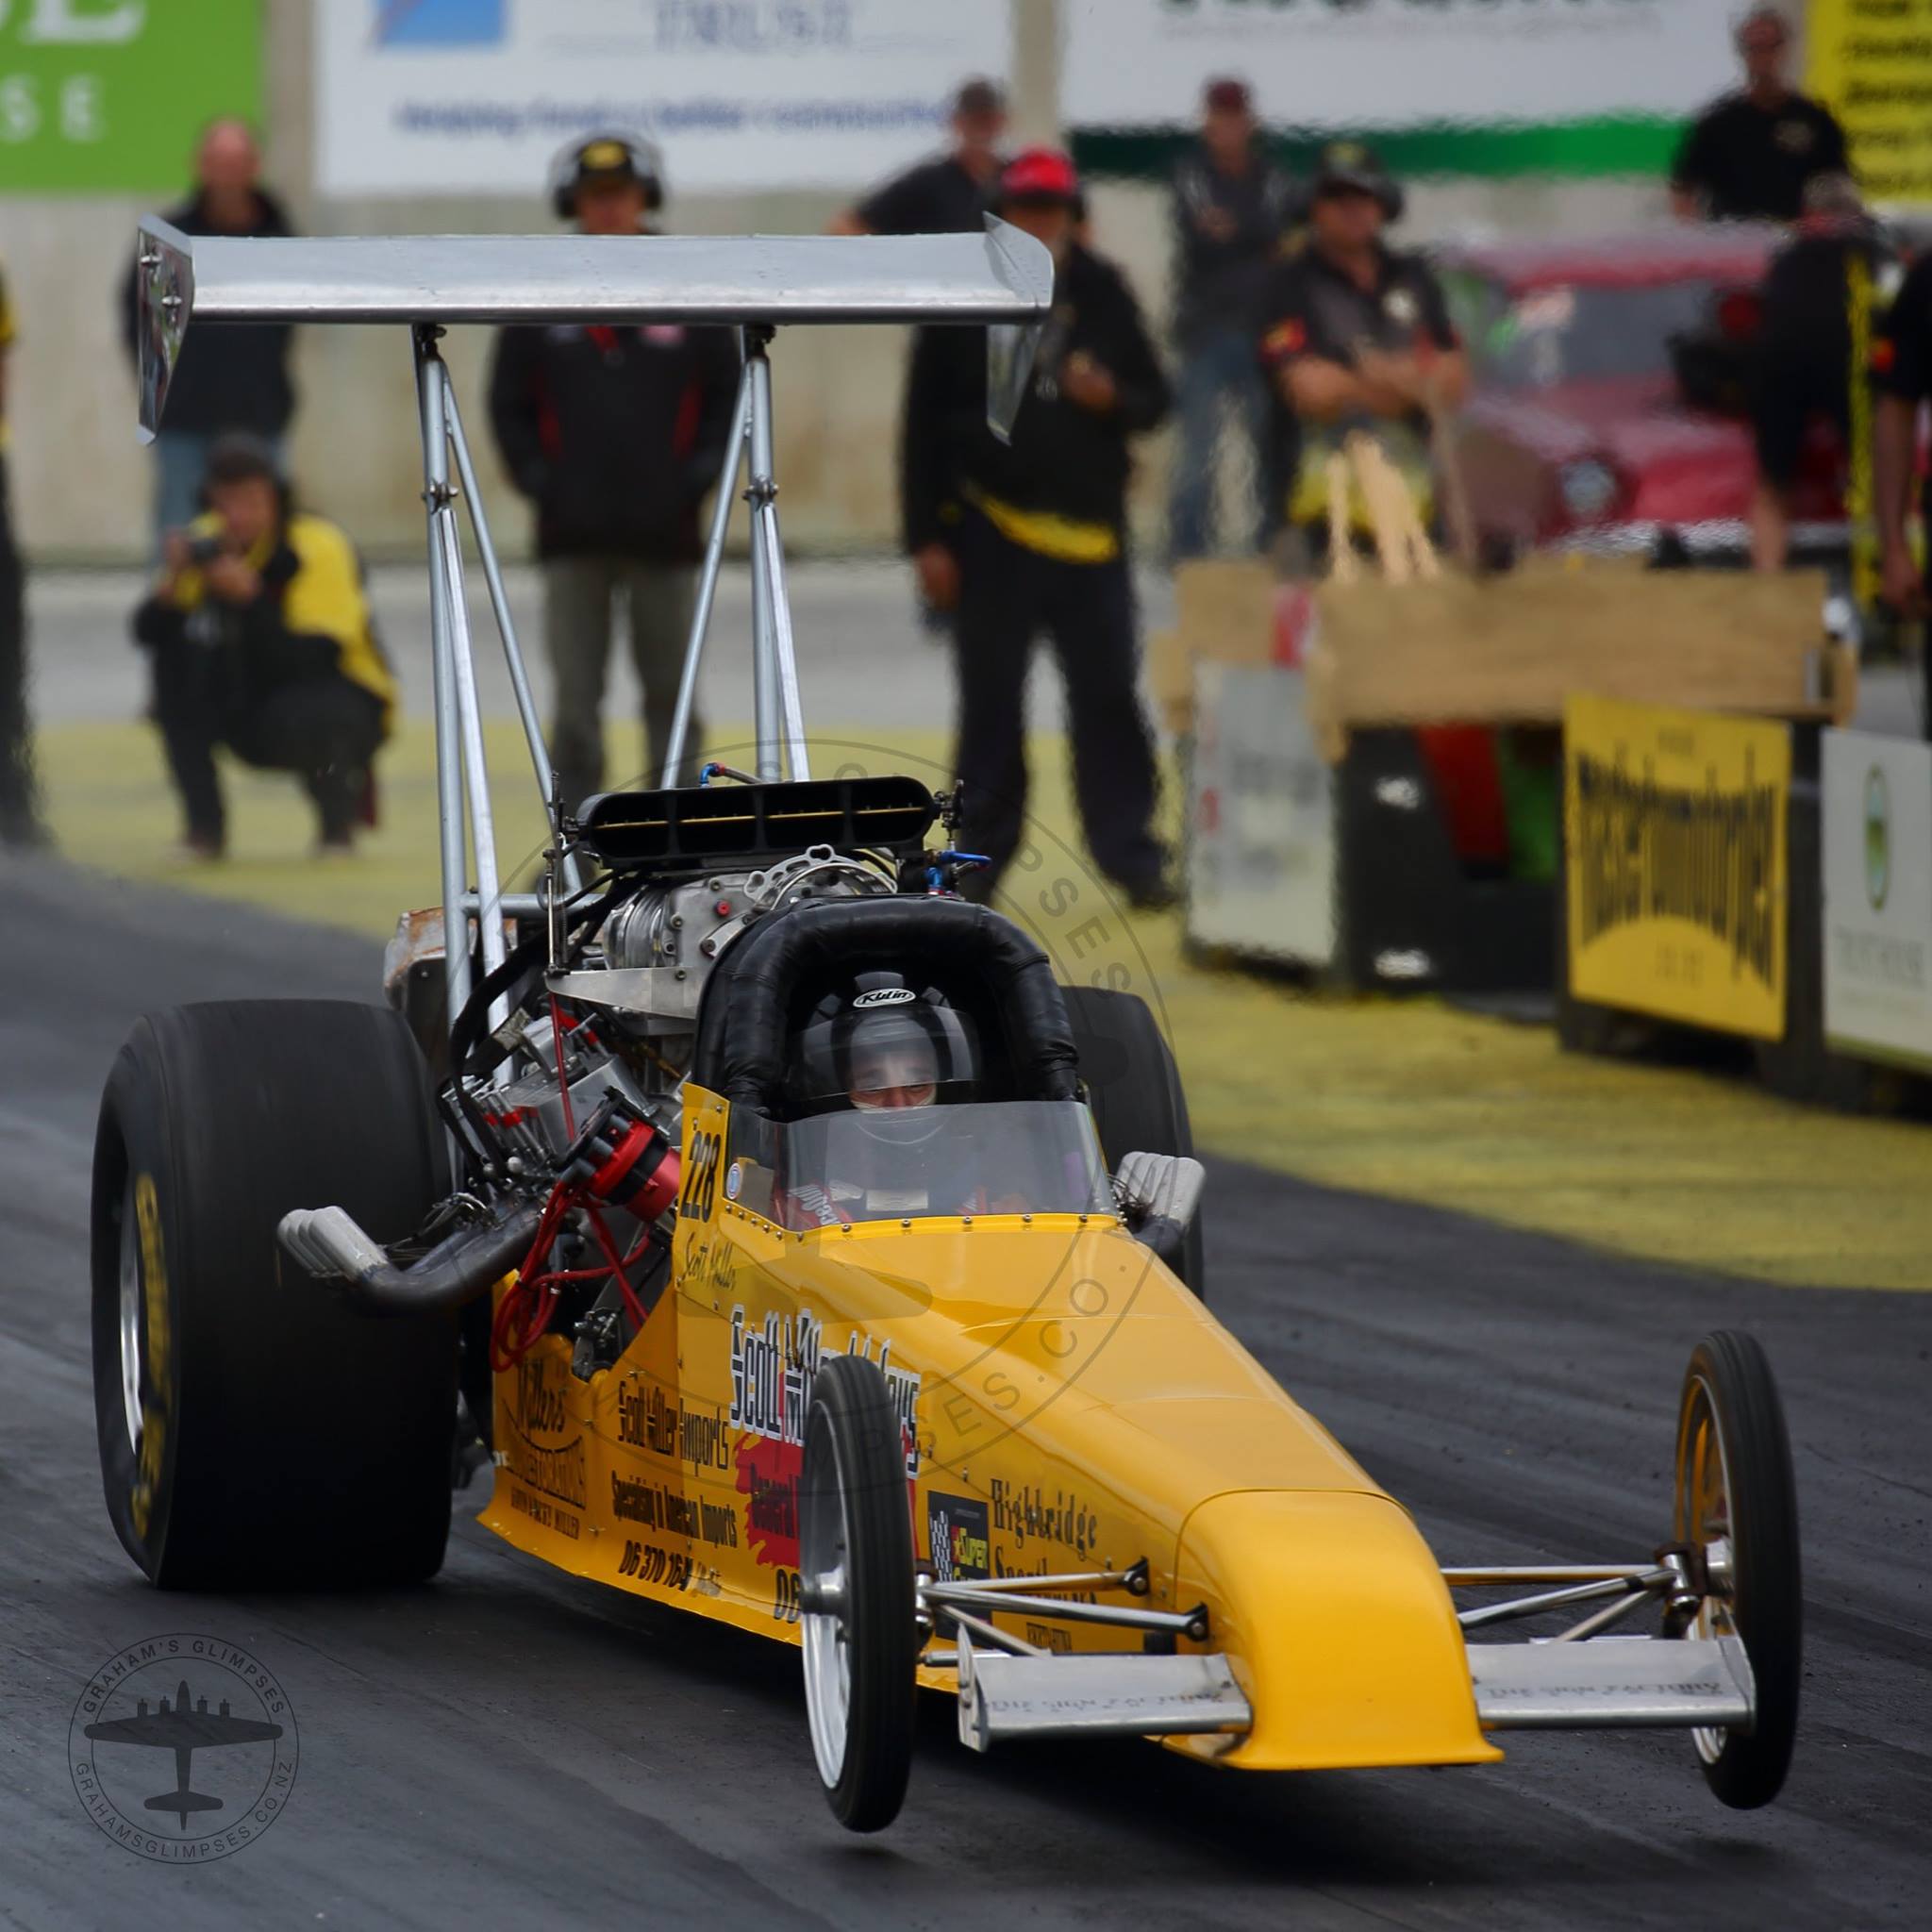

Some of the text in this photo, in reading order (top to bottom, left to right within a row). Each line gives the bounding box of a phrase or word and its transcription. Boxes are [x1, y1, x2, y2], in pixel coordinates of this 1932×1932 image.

[680, 1131, 721, 1224] 228
[991, 1478, 1098, 1562] Highbridge
[618, 1540, 641, 1576] 06
[638, 1544, 667, 1585] 370
